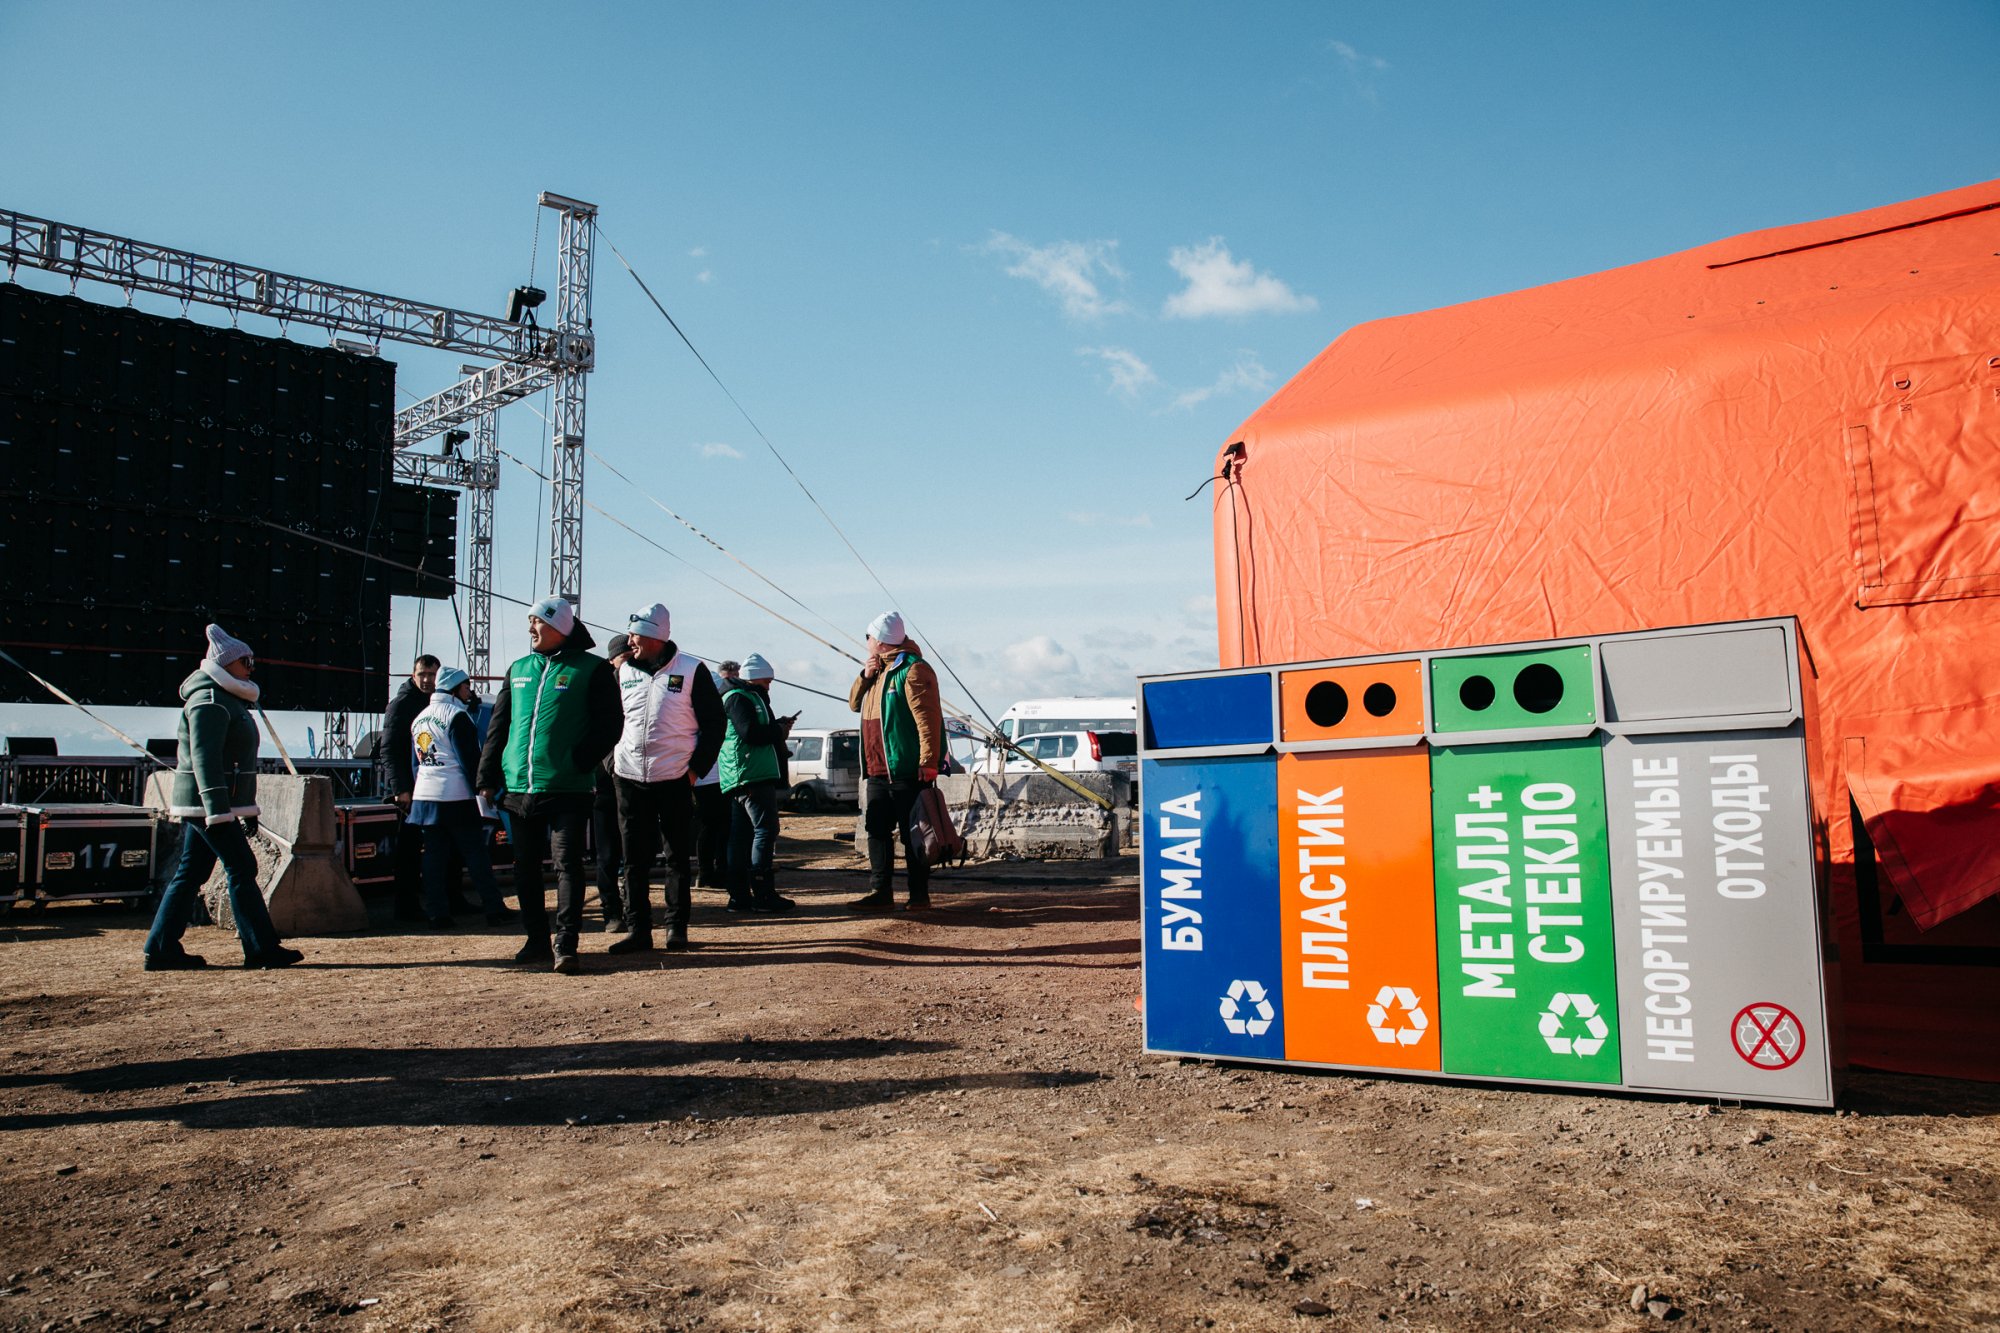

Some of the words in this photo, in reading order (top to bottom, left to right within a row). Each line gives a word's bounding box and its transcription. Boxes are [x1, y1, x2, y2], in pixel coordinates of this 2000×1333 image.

[80, 843, 119, 868] 17
[1160, 792, 1202, 950] БУМАГА
[1298, 787, 1349, 989] ПЛАСТИК
[1455, 786, 1515, 997] МЕТАЛЛ+
[1521, 783, 1584, 962] СТЕКЛО
[1633, 757, 1694, 1061] НЕСОРТИРУЕМЫЕ
[1710, 755, 1770, 898] ОТХОДЫ
